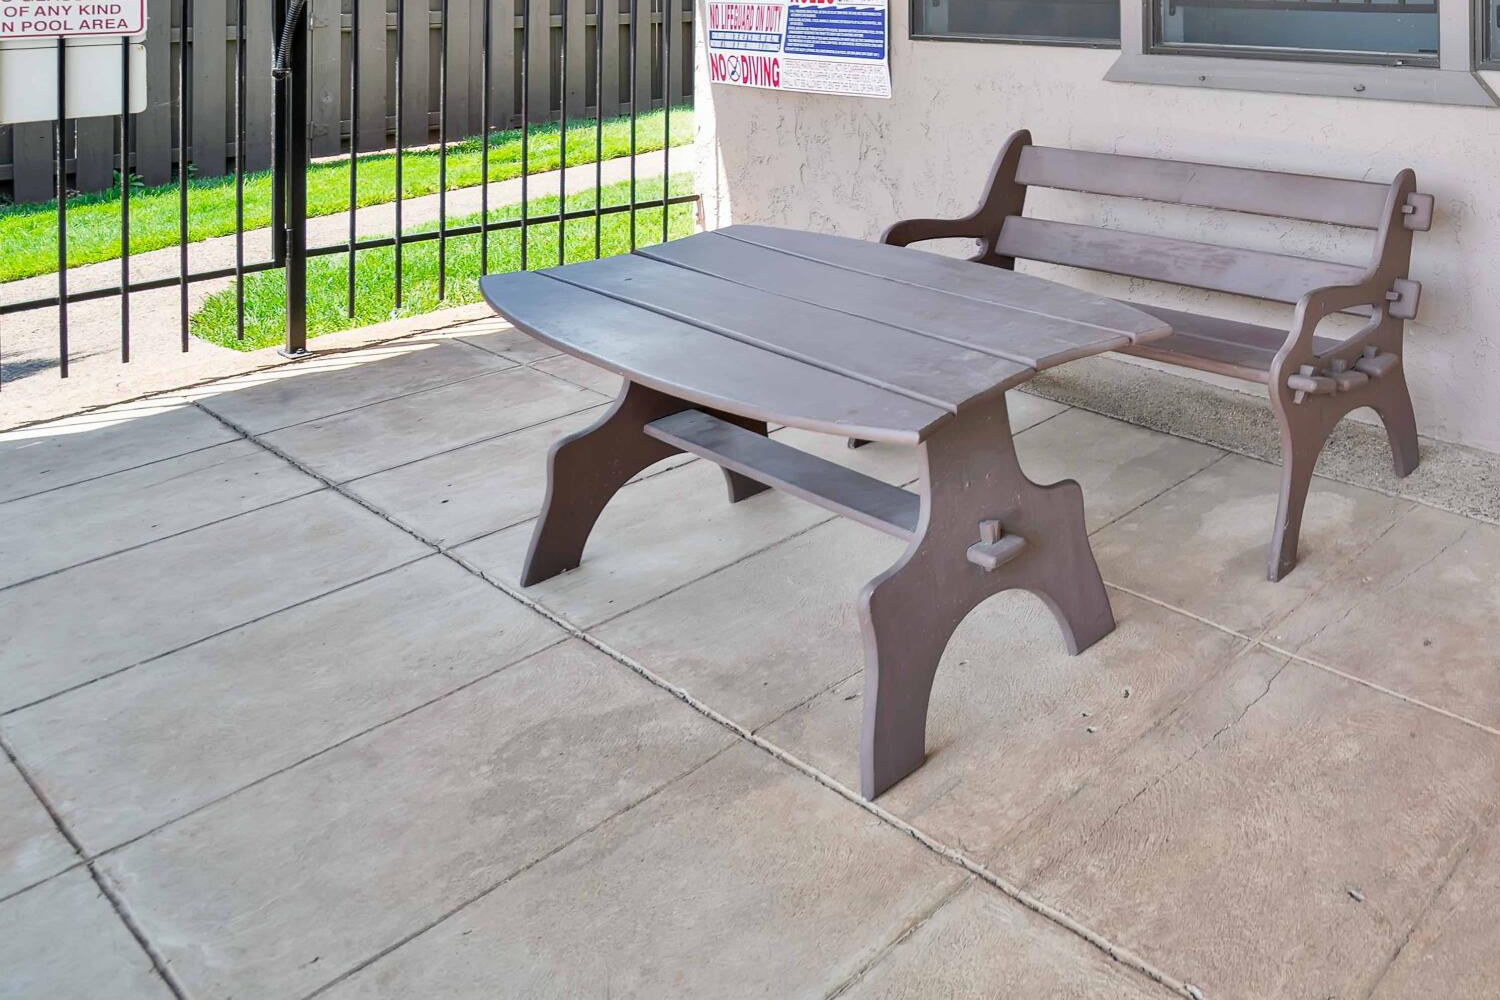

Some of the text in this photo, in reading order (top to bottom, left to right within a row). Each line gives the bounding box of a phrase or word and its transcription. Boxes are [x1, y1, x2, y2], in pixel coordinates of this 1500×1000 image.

[4, 4, 122, 17] OF ANY KIND
[710, 4, 782, 32] NO LIFEGUARD ON DUTY
[21, 20, 74, 32] POOL
[79, 18, 129, 30] AREA
[710, 52, 727, 82] NO
[740, 55, 780, 88] DIVING
